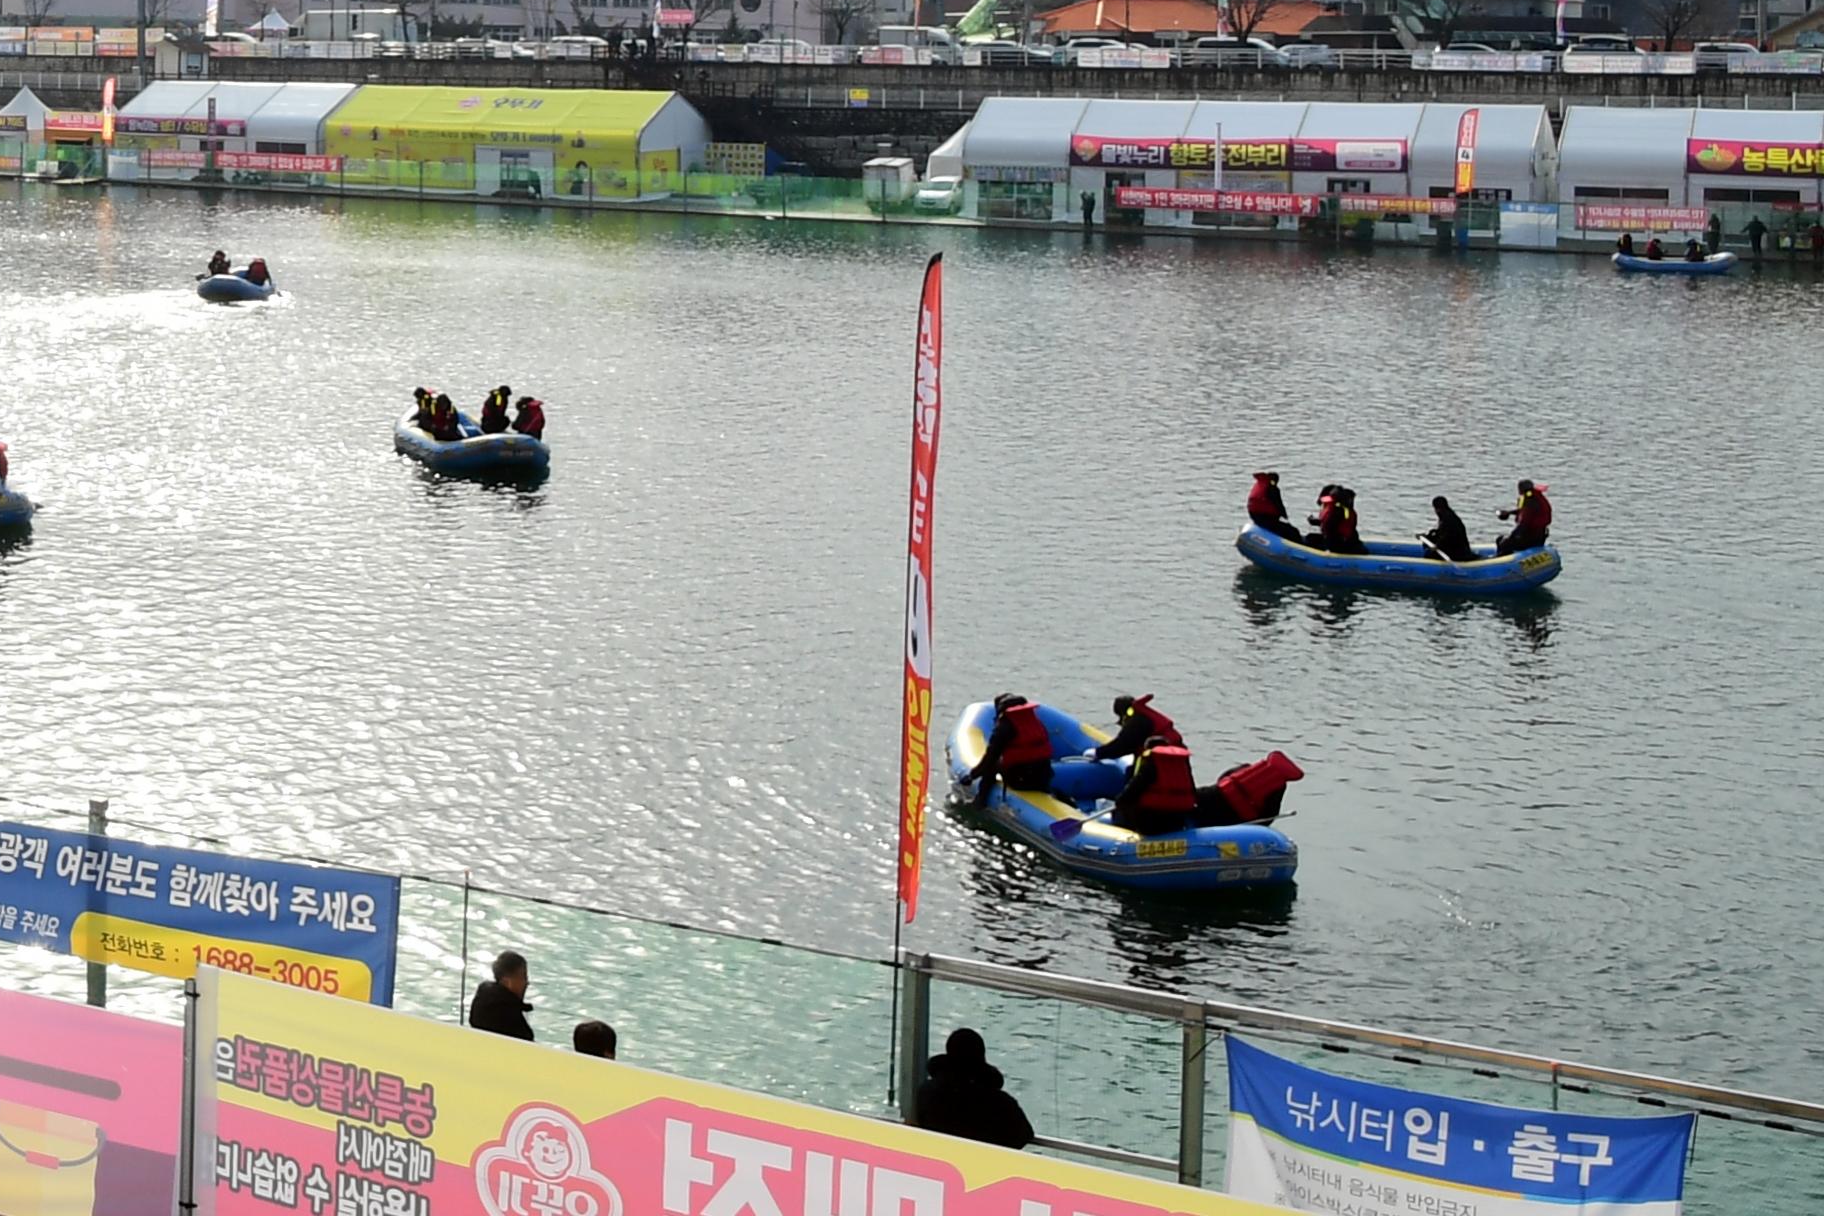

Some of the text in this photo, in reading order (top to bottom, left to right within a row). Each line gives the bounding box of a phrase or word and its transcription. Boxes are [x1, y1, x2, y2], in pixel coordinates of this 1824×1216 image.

[56, 843, 161, 899] 여러분도
[169, 864, 280, 922] 함께찾아
[289, 885, 377, 933] 주세요
[20, 910, 60, 938] 주세요
[100, 931, 167, 962] 전화번호
[1507, 1124, 1614, 1187] 출구
[1348, 1177, 1399, 1207] 음식물
